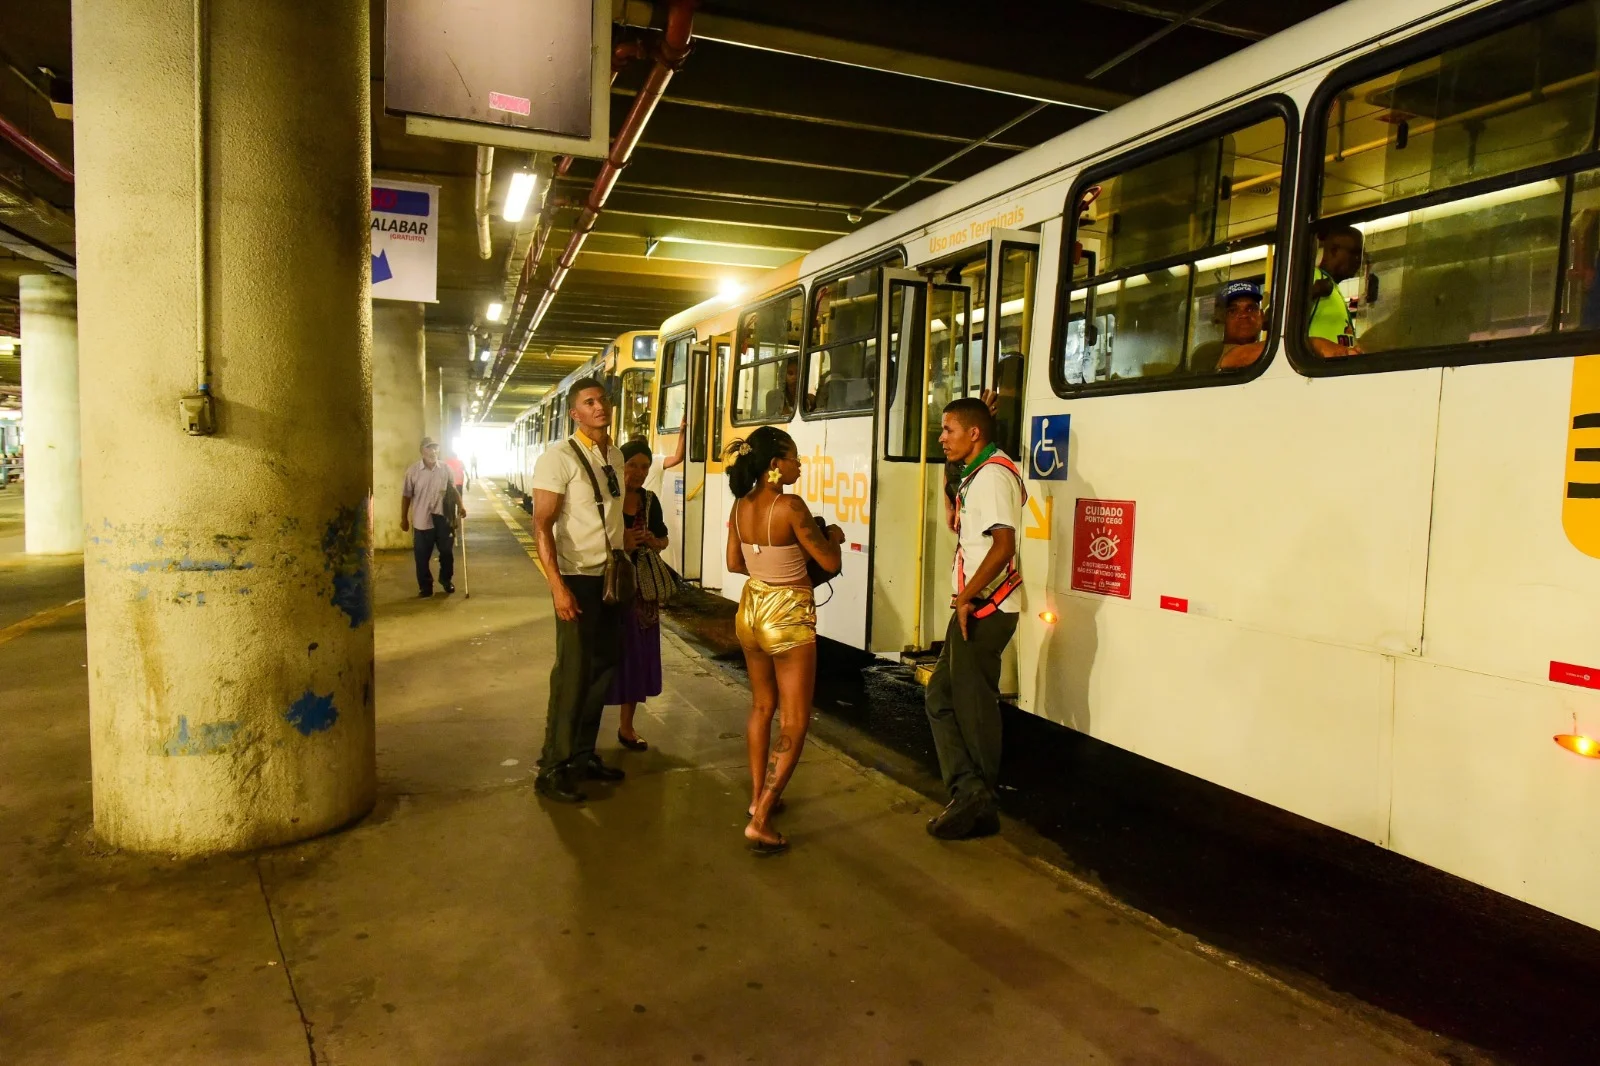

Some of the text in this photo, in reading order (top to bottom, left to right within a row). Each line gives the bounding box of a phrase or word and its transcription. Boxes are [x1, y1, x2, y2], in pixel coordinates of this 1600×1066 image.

[370, 217, 428, 235] ALABAR
[929, 205, 1024, 253] Uso nos Terminais
[390, 233, 424, 242] (GRATUITO)
[1085, 505, 1123, 517] CUIDADO
[1105, 517, 1123, 525] CEGO
